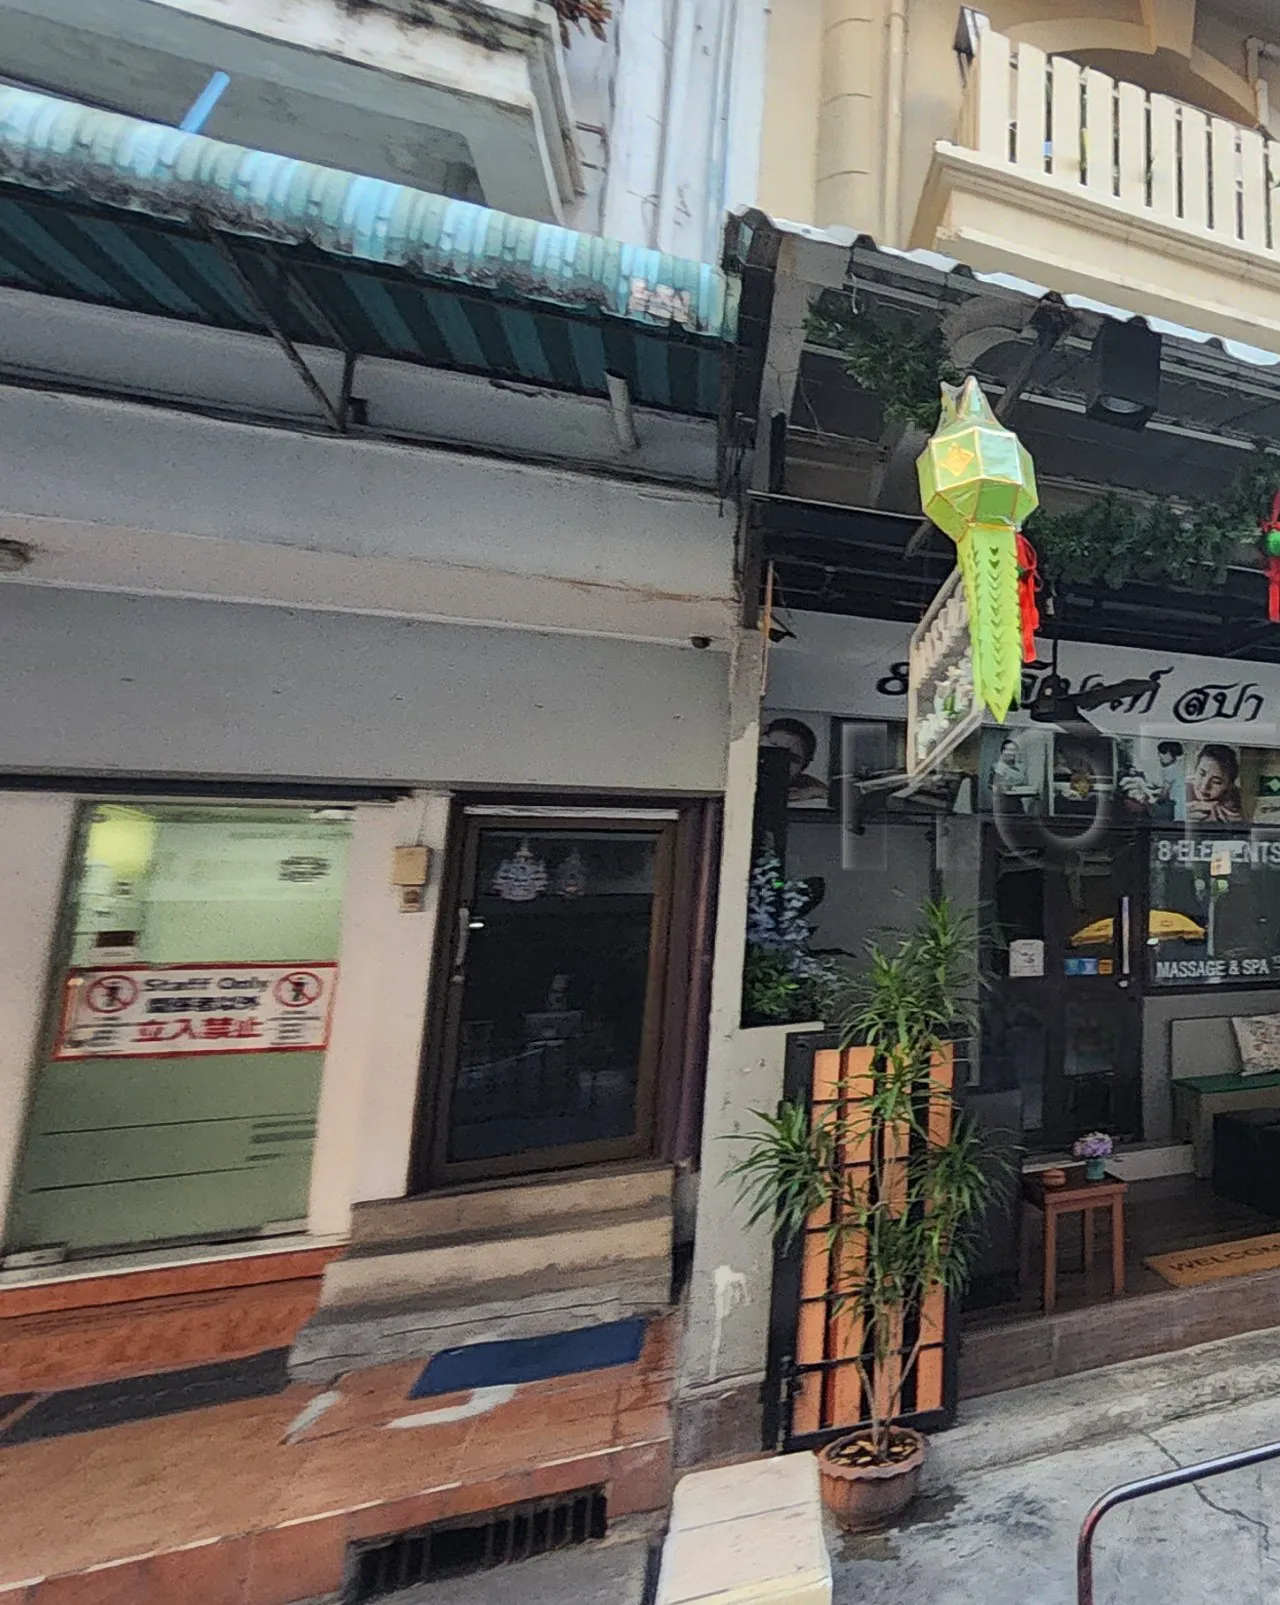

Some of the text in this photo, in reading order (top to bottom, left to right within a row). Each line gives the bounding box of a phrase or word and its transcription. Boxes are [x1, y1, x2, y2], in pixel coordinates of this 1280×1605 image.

[1173, 681, 1265, 724] สปา
[1157, 840, 1173, 862] 8
[1156, 957, 1271, 978] MASSAGE & SPA
